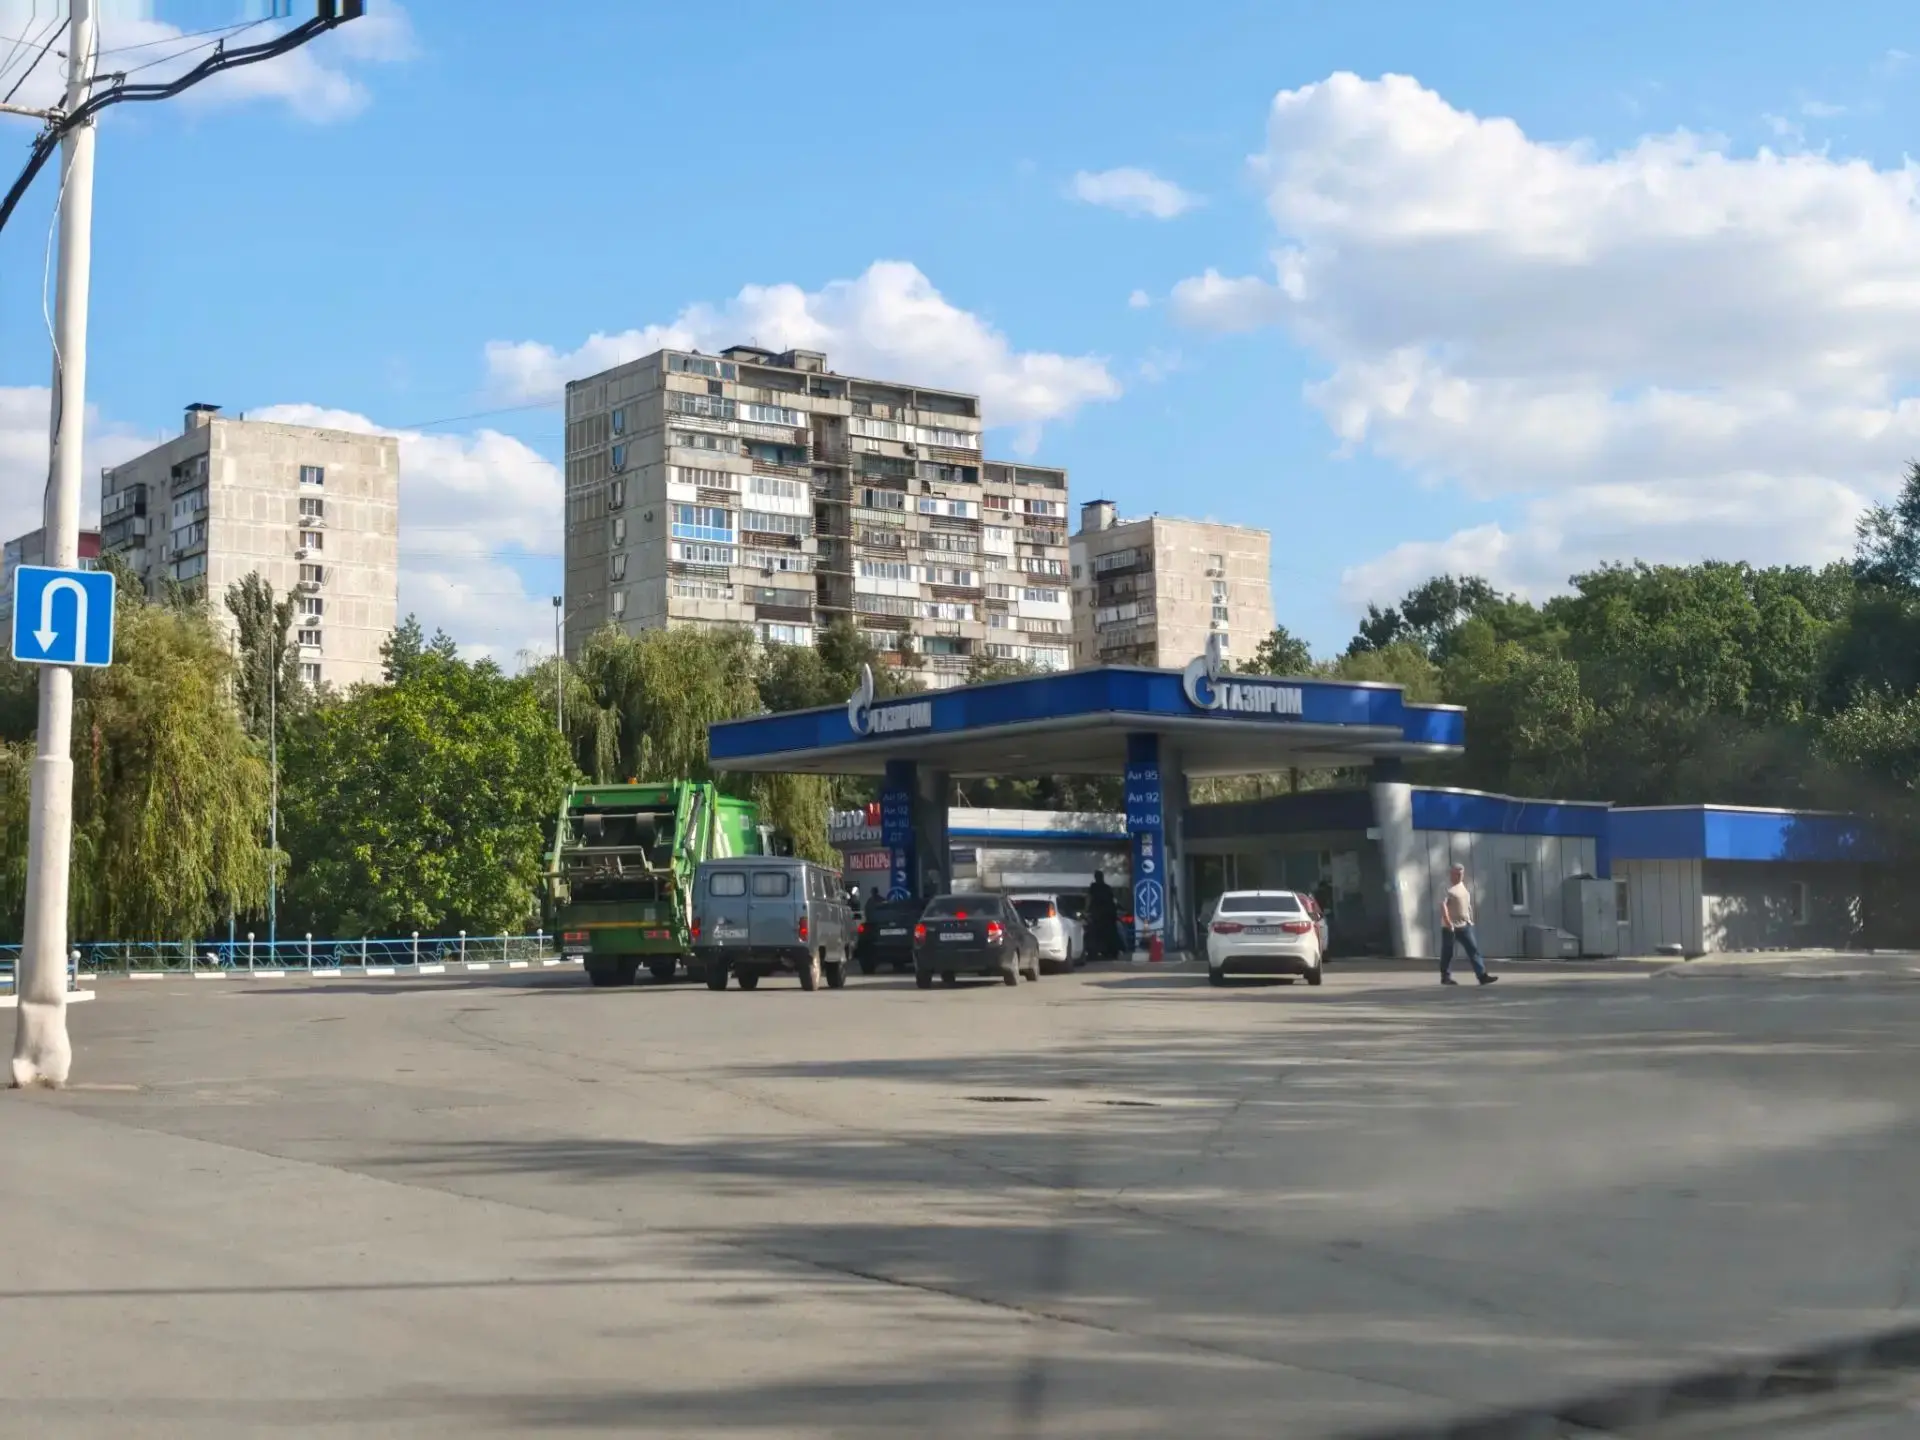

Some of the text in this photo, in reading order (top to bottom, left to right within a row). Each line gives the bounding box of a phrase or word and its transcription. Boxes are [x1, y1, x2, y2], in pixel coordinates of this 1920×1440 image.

[1218, 682, 1303, 714] ГАЗПРОМ
[1144, 770, 1158, 780] 95
[1145, 792, 1160, 803] 92
[1145, 814, 1160, 824] 80
